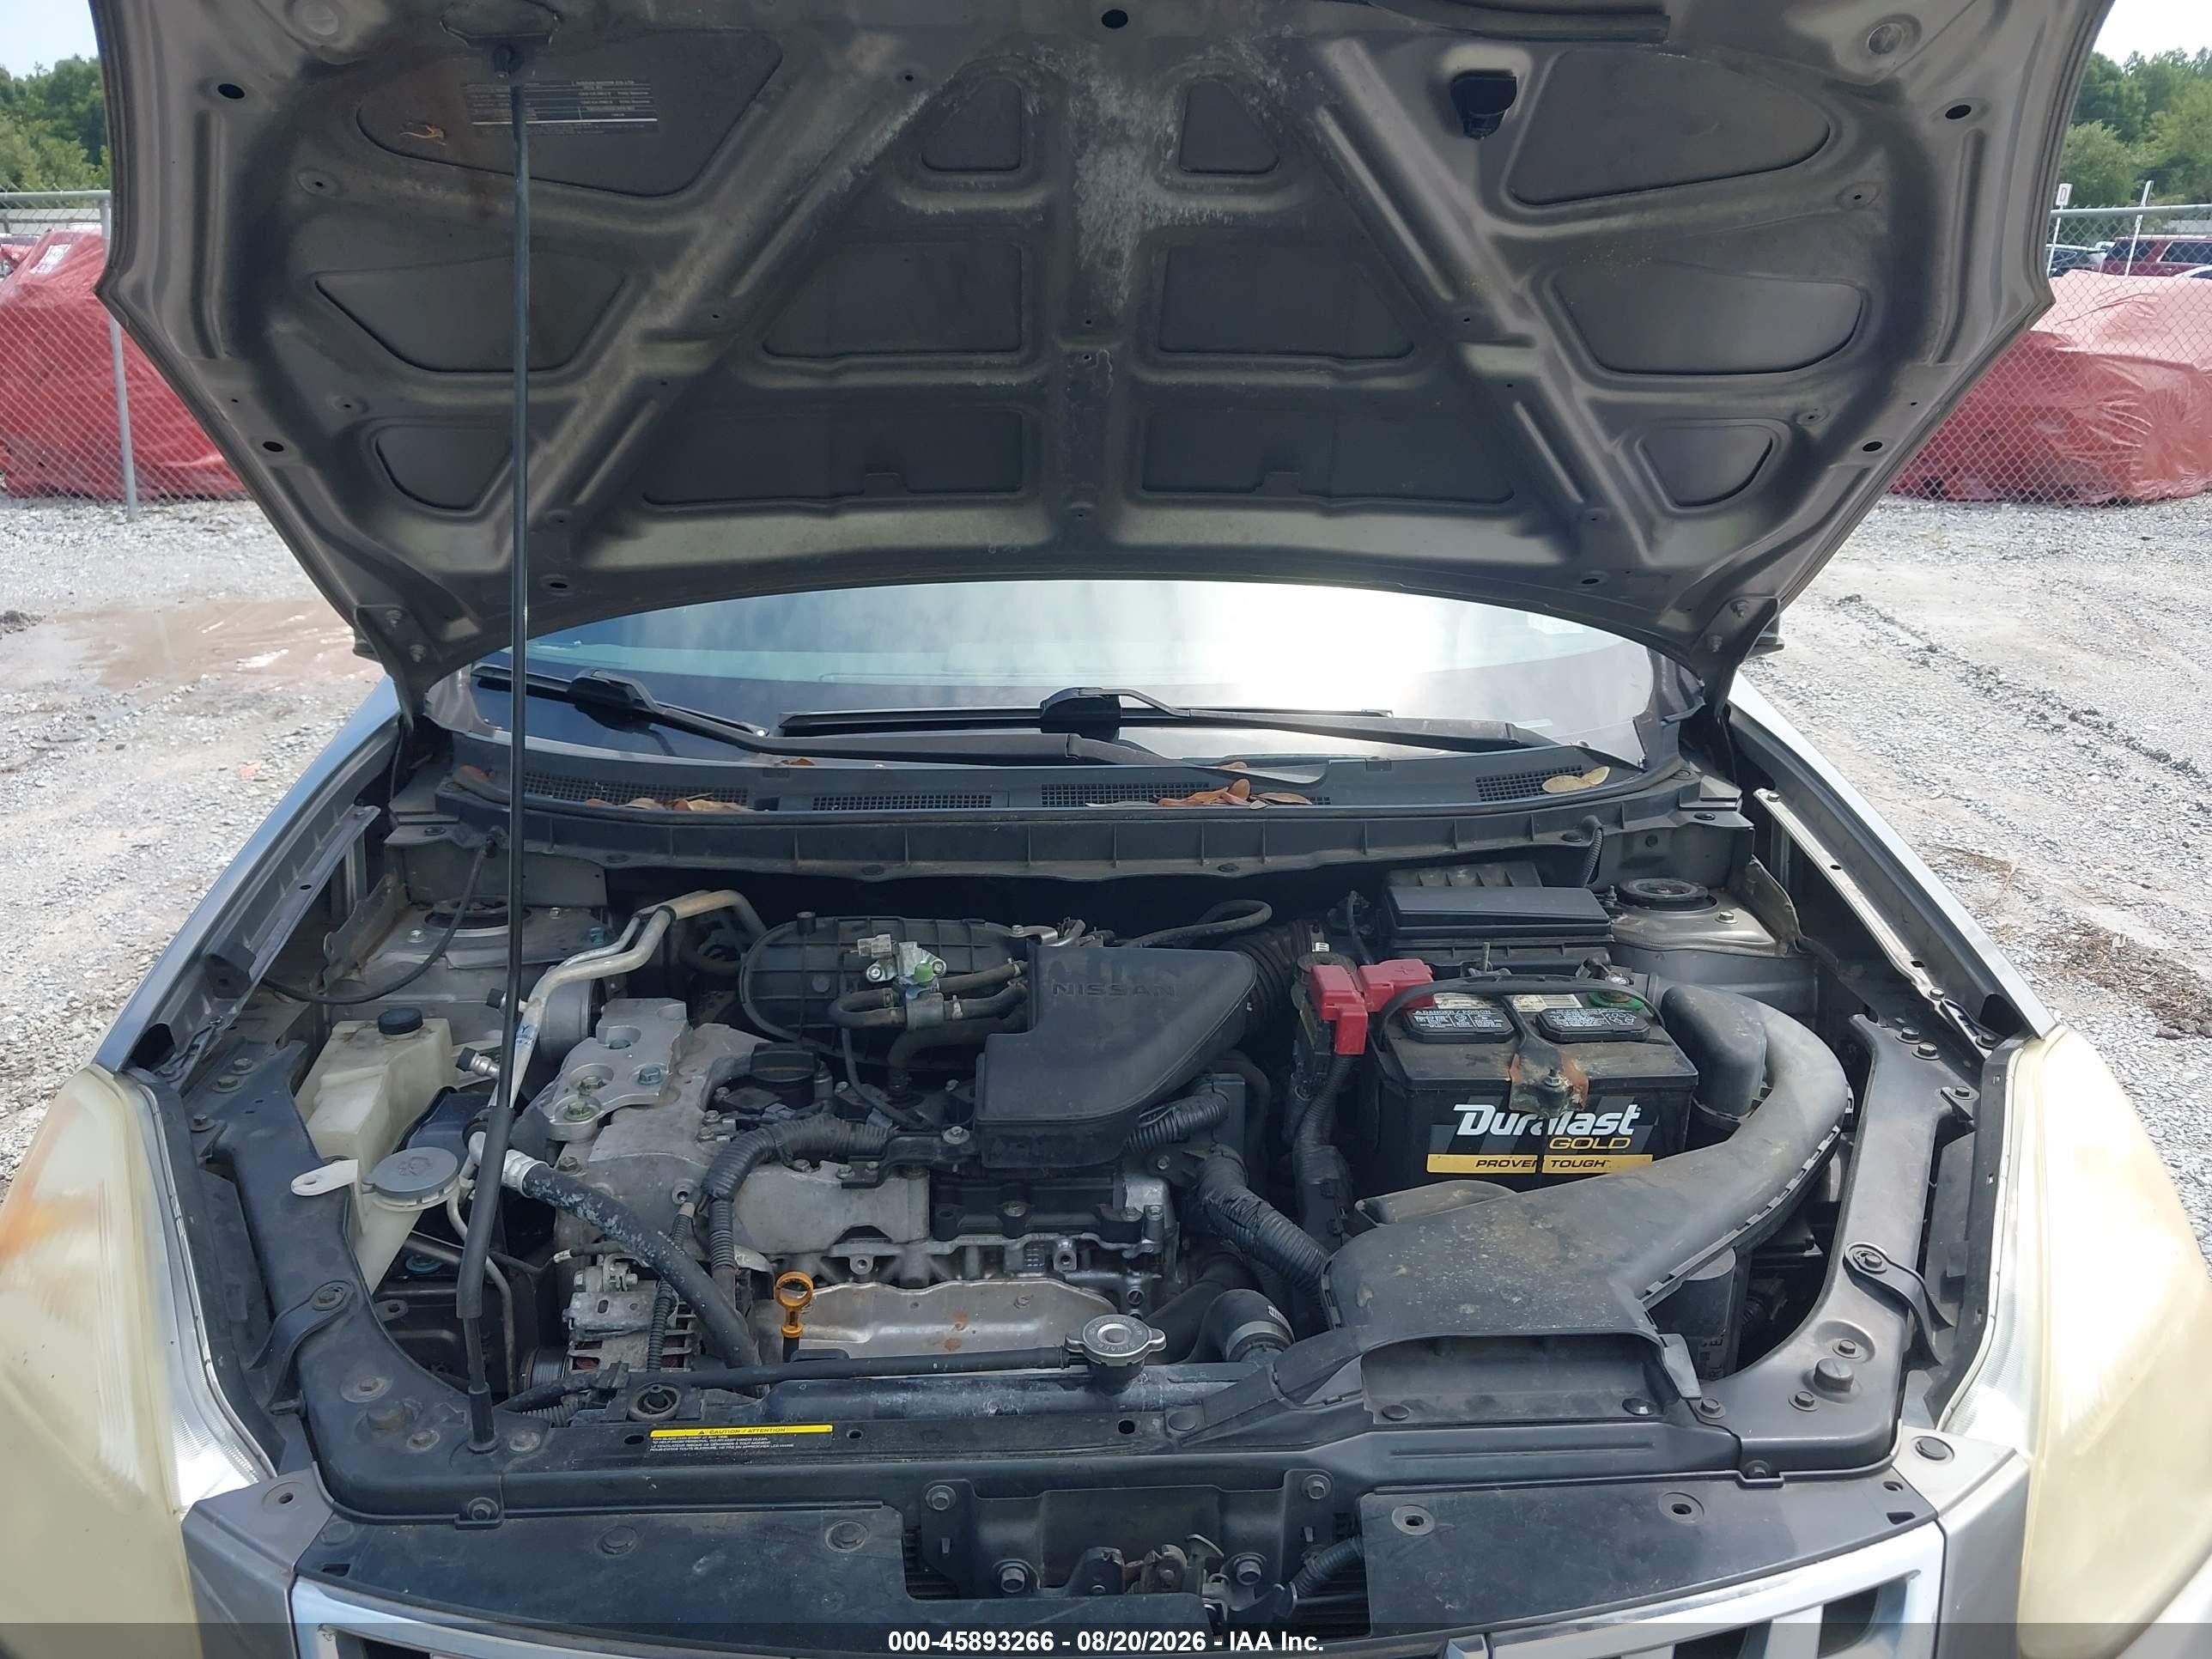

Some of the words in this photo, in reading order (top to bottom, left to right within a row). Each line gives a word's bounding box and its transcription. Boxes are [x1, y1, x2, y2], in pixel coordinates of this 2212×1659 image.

[1052, 982, 1176, 997] NISSAN
[1452, 1103, 1640, 1136] Duralast
[1548, 1137, 1632, 1150] GOLD
[1551, 1158, 1605, 1169] TOUGH
